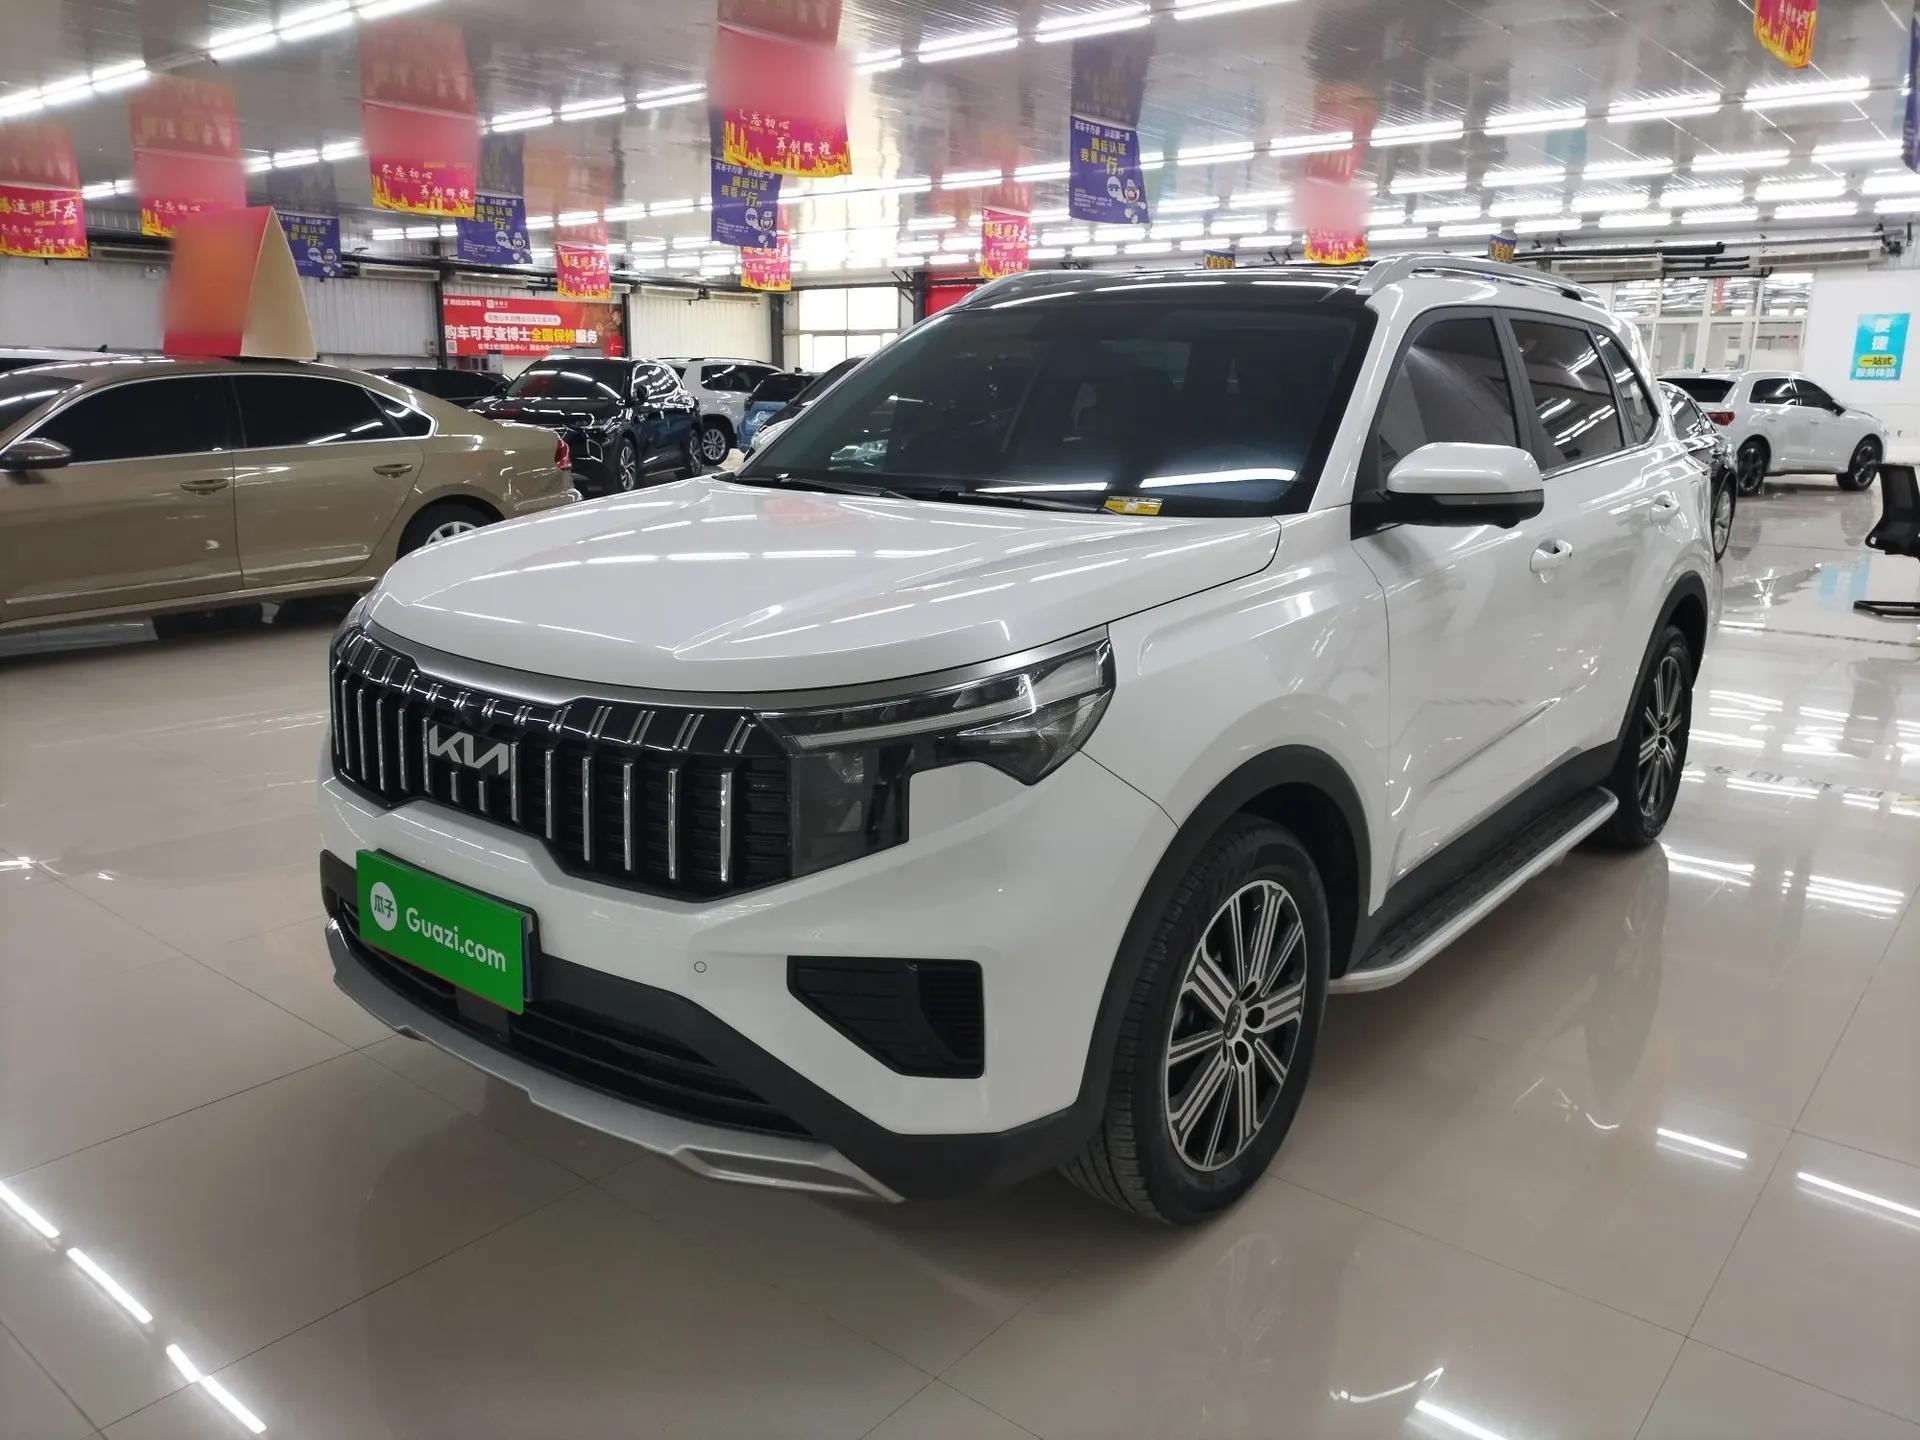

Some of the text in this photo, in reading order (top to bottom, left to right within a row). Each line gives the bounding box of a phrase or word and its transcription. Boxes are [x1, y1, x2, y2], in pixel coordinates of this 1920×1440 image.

[776, 136, 832, 158] 再创辉煌
[382, 163, 433, 180] 不忘初心
[445, 325, 598, 344] 购车可享查博士全国保修服务
[429, 724, 509, 776] KIA
[374, 894, 395, 919] 瓜子
[406, 907, 506, 973] Guazi.com
